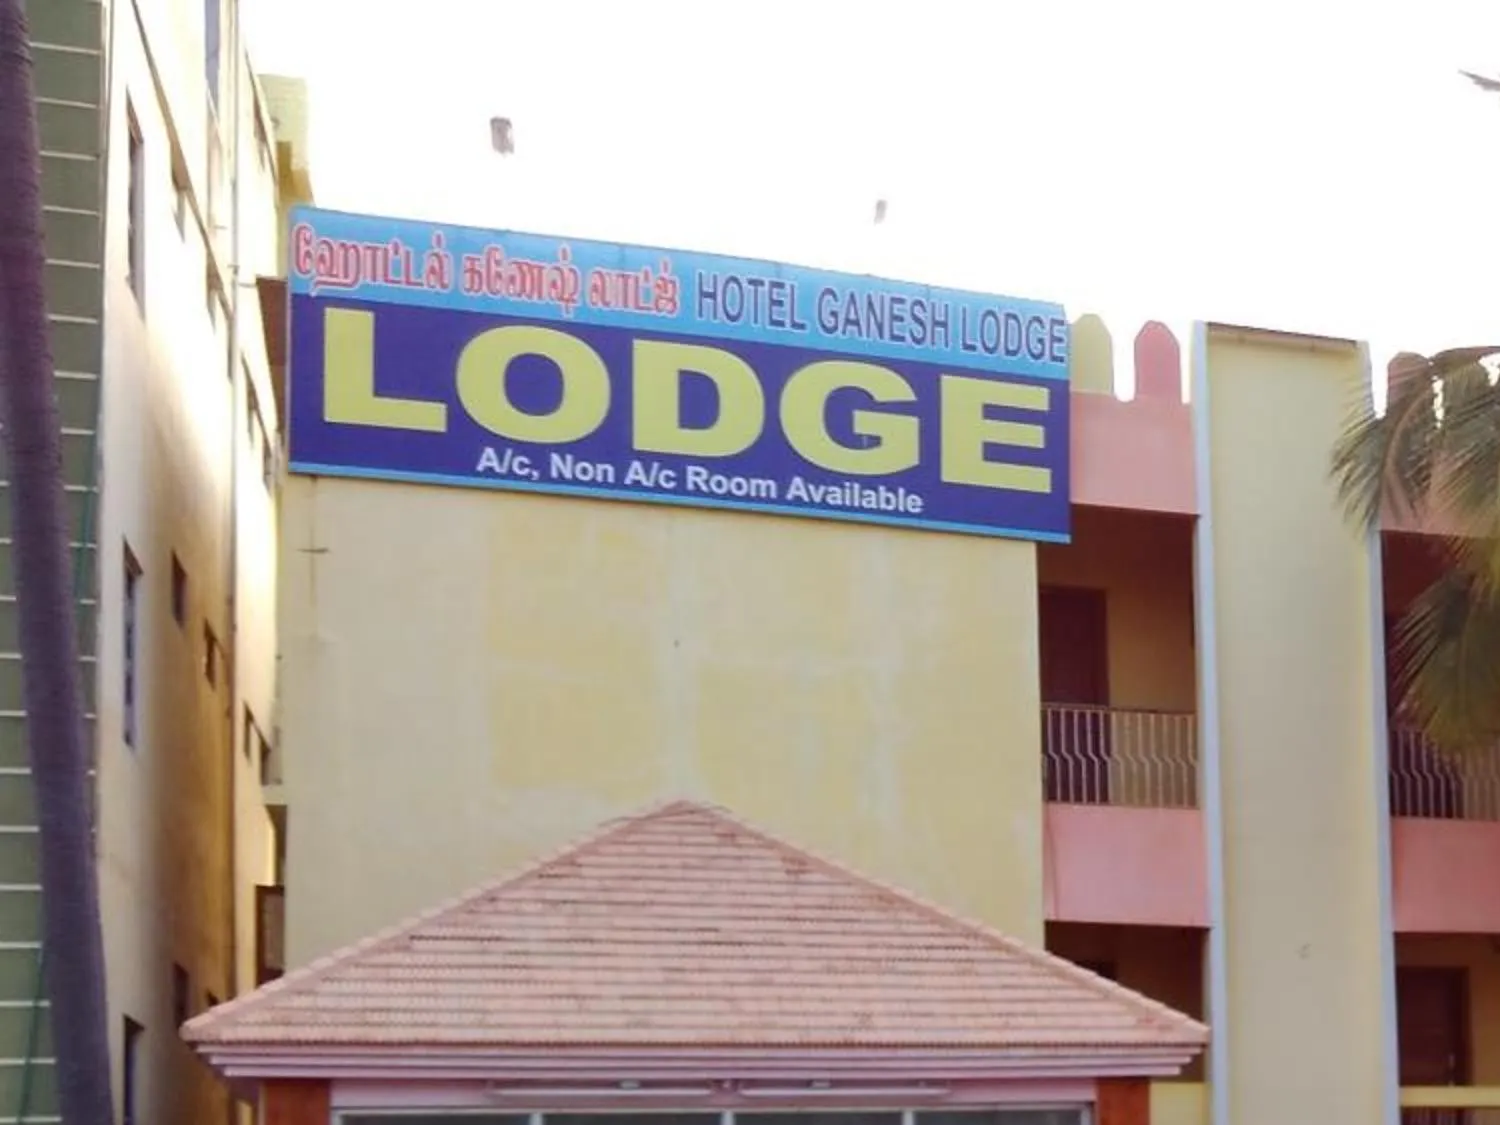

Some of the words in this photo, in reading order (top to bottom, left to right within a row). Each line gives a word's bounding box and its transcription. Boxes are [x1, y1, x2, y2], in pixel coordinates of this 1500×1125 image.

[463, 242, 580, 317] கணேஷ்
[696, 271, 806, 331] HOTEL
[817, 287, 949, 348] GANESH
[960, 306, 1065, 363] LODGE
[323, 307, 1052, 494] LODGE
[476, 447, 540, 481] A/c,
[550, 453, 615, 484] Non
[624, 460, 677, 490] A/c
[686, 466, 777, 499] Room
[787, 477, 924, 514] Available
